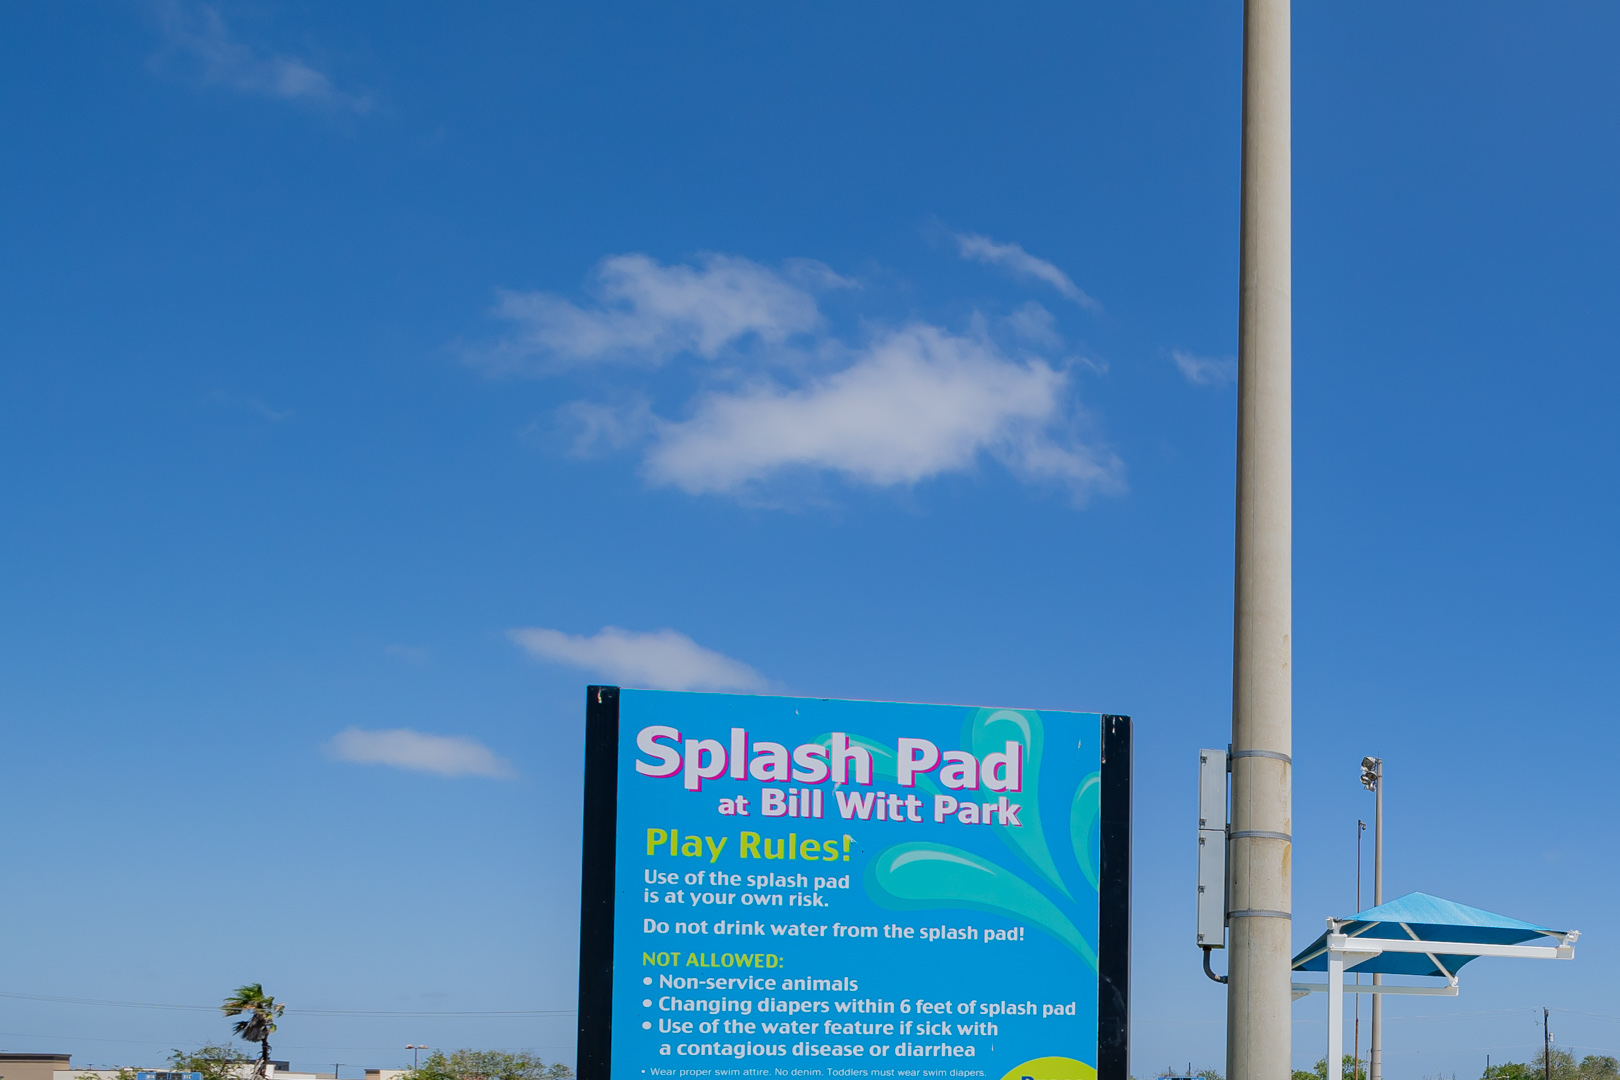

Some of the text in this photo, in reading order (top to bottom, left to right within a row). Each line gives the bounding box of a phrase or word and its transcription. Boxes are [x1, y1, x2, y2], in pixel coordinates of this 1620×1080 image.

[635, 726, 1023, 793] Splash Pad
[717, 787, 1022, 826] at Bill Witt Park
[646, 827, 852, 863] Play Rules!
[644, 868, 850, 891] Use of the splash pad
[643, 887, 829, 908] is at your own risk.
[643, 918, 1024, 944] Do not drink water from the splash pad!
[642, 951, 784, 969] NOT ALLOWED:
[659, 973, 859, 992] Non-service animals
[658, 995, 1076, 1019] Changing diapers within 6 feet of splash pad
[658, 1018, 999, 1036] Use of the water feature if sick with
[659, 1041, 976, 1059] a contagious disease or diarrhea
